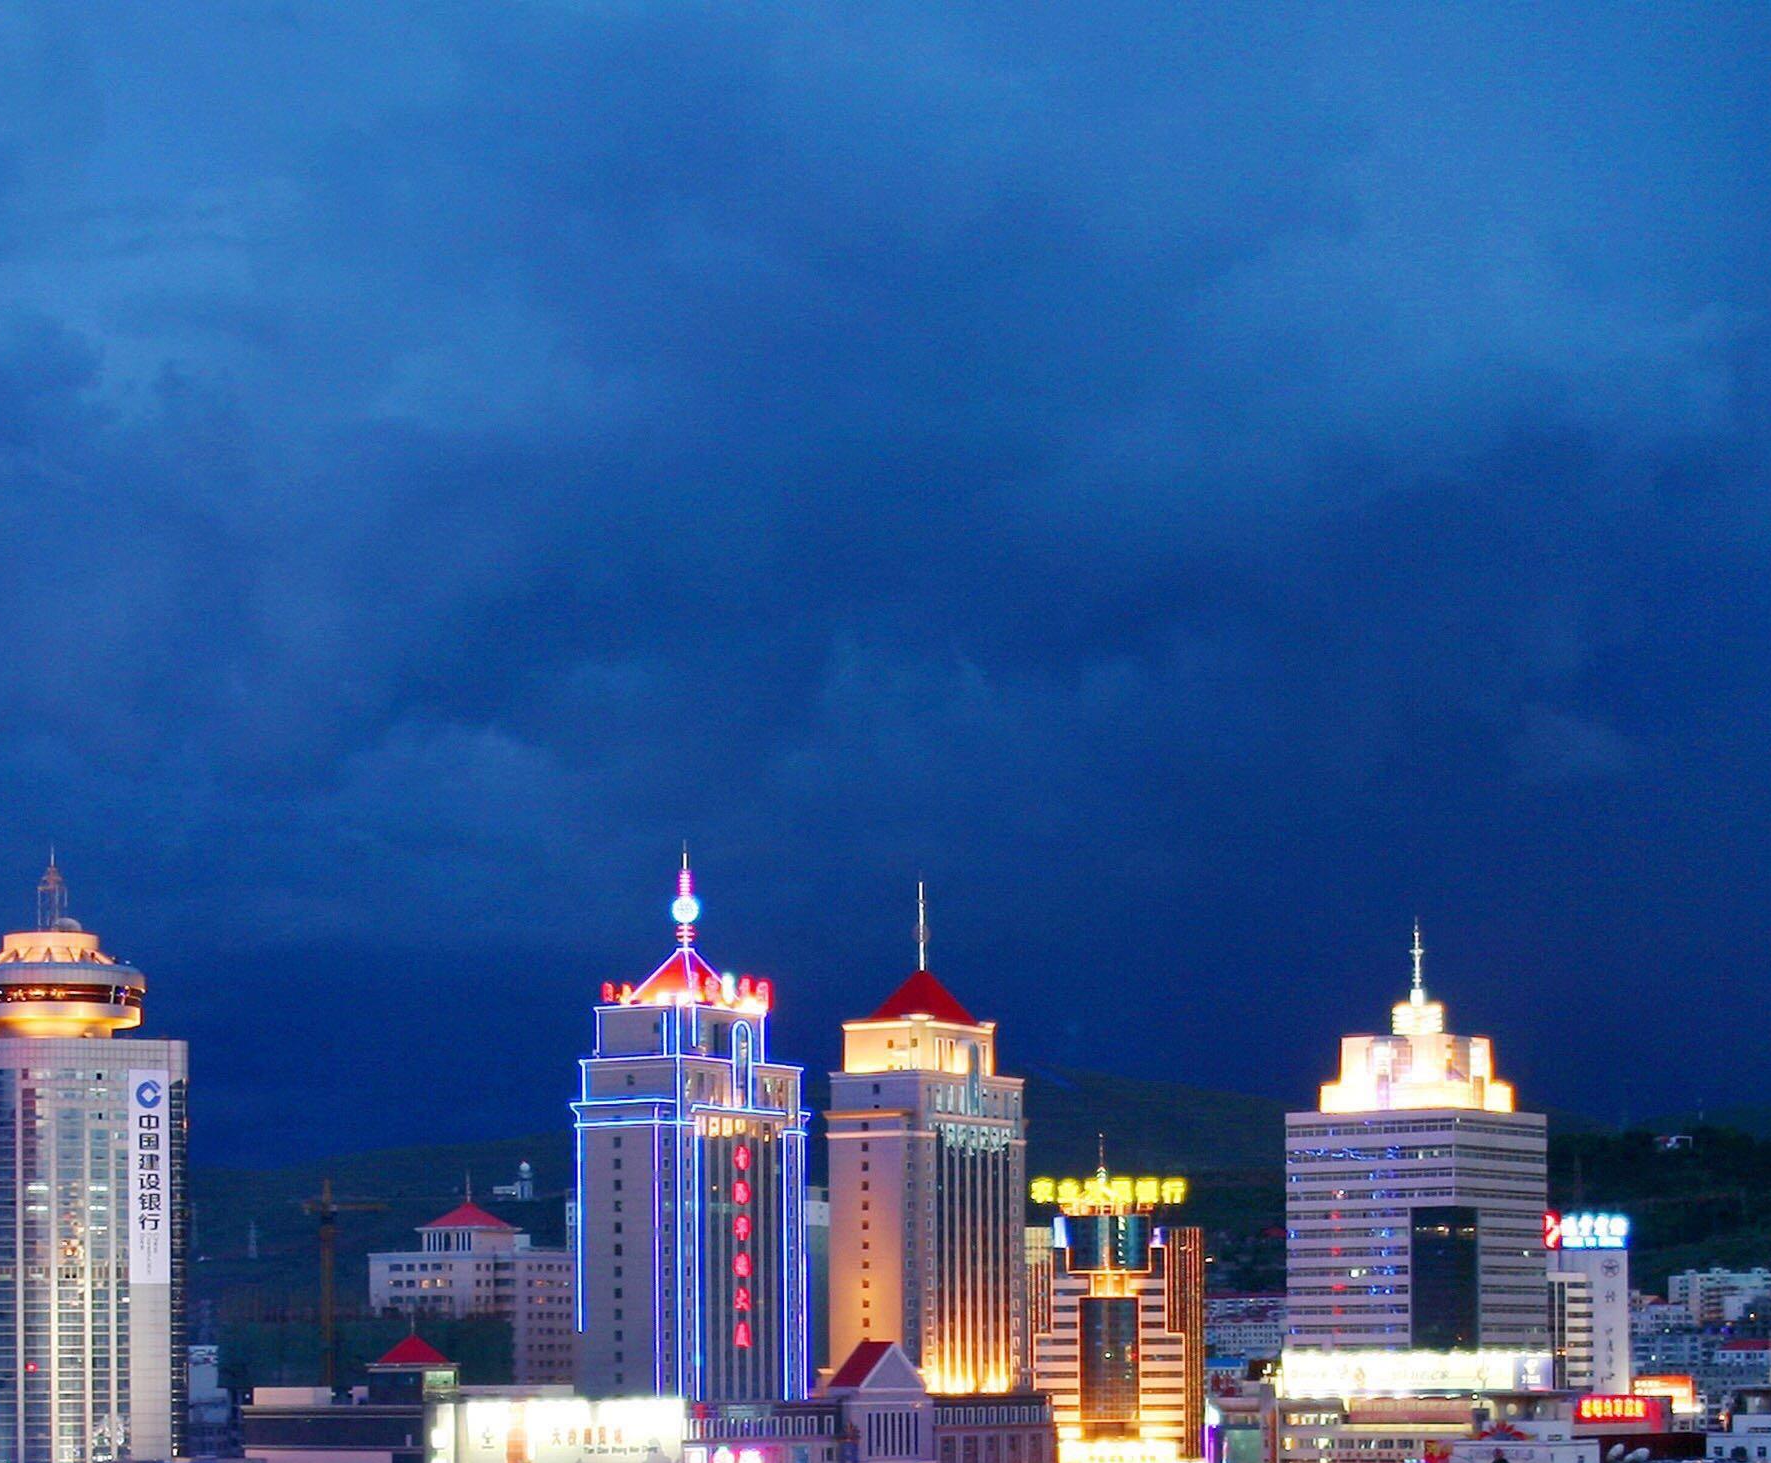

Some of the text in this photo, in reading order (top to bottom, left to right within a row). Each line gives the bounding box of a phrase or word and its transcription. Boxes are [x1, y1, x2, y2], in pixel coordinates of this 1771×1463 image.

[138, 1114, 162, 1230] 中国建设银行
